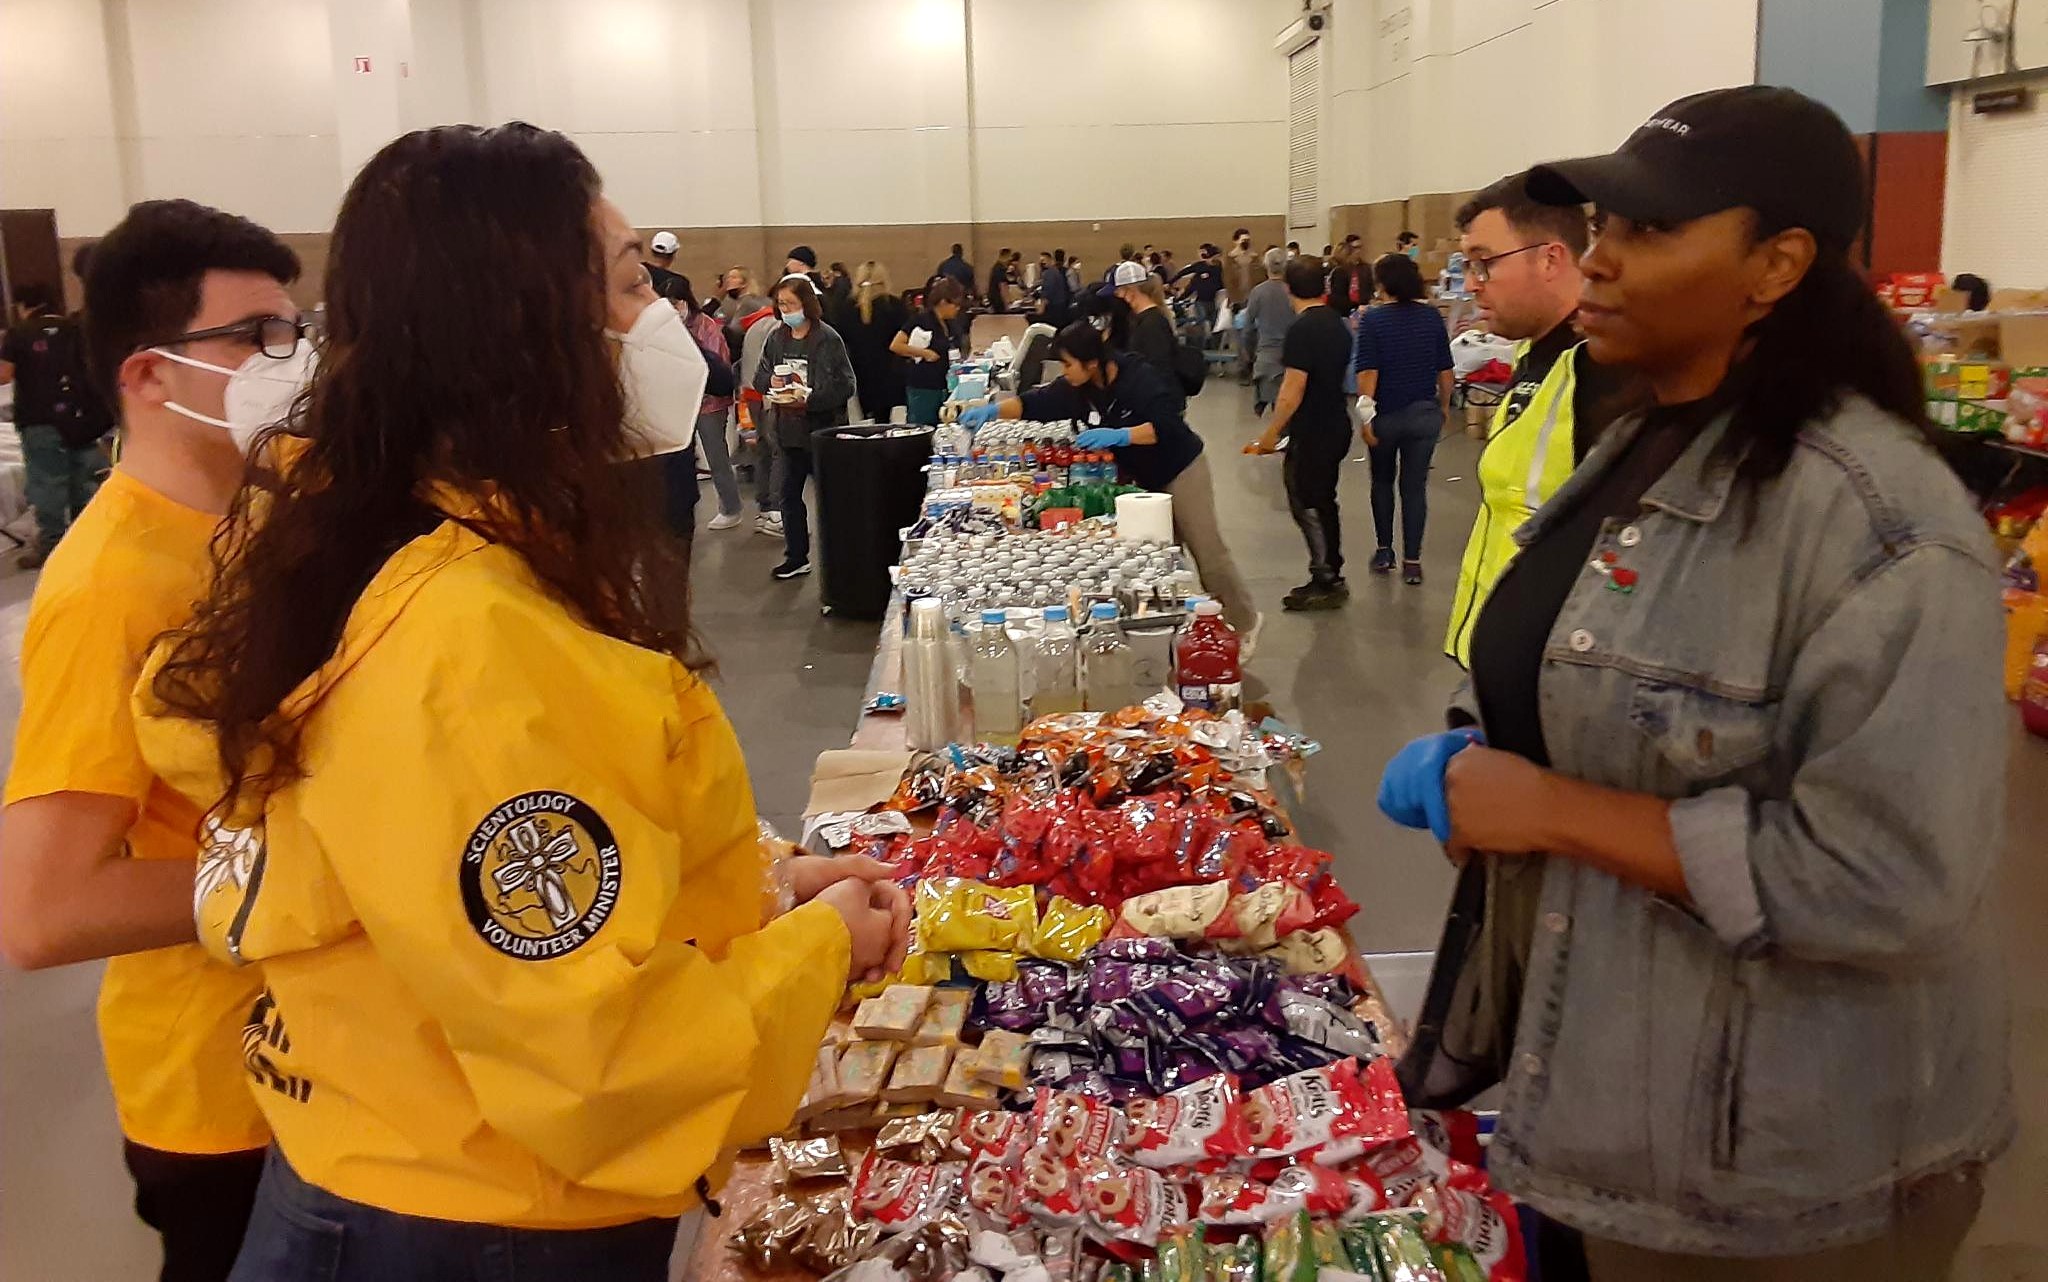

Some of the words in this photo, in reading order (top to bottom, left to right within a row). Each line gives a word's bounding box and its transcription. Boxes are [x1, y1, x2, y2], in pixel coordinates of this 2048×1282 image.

[466, 794, 576, 864] SCIENTOLOGY
[482, 918, 586, 957] VOLUNTEER
[581, 844, 619, 933] MINISTER
